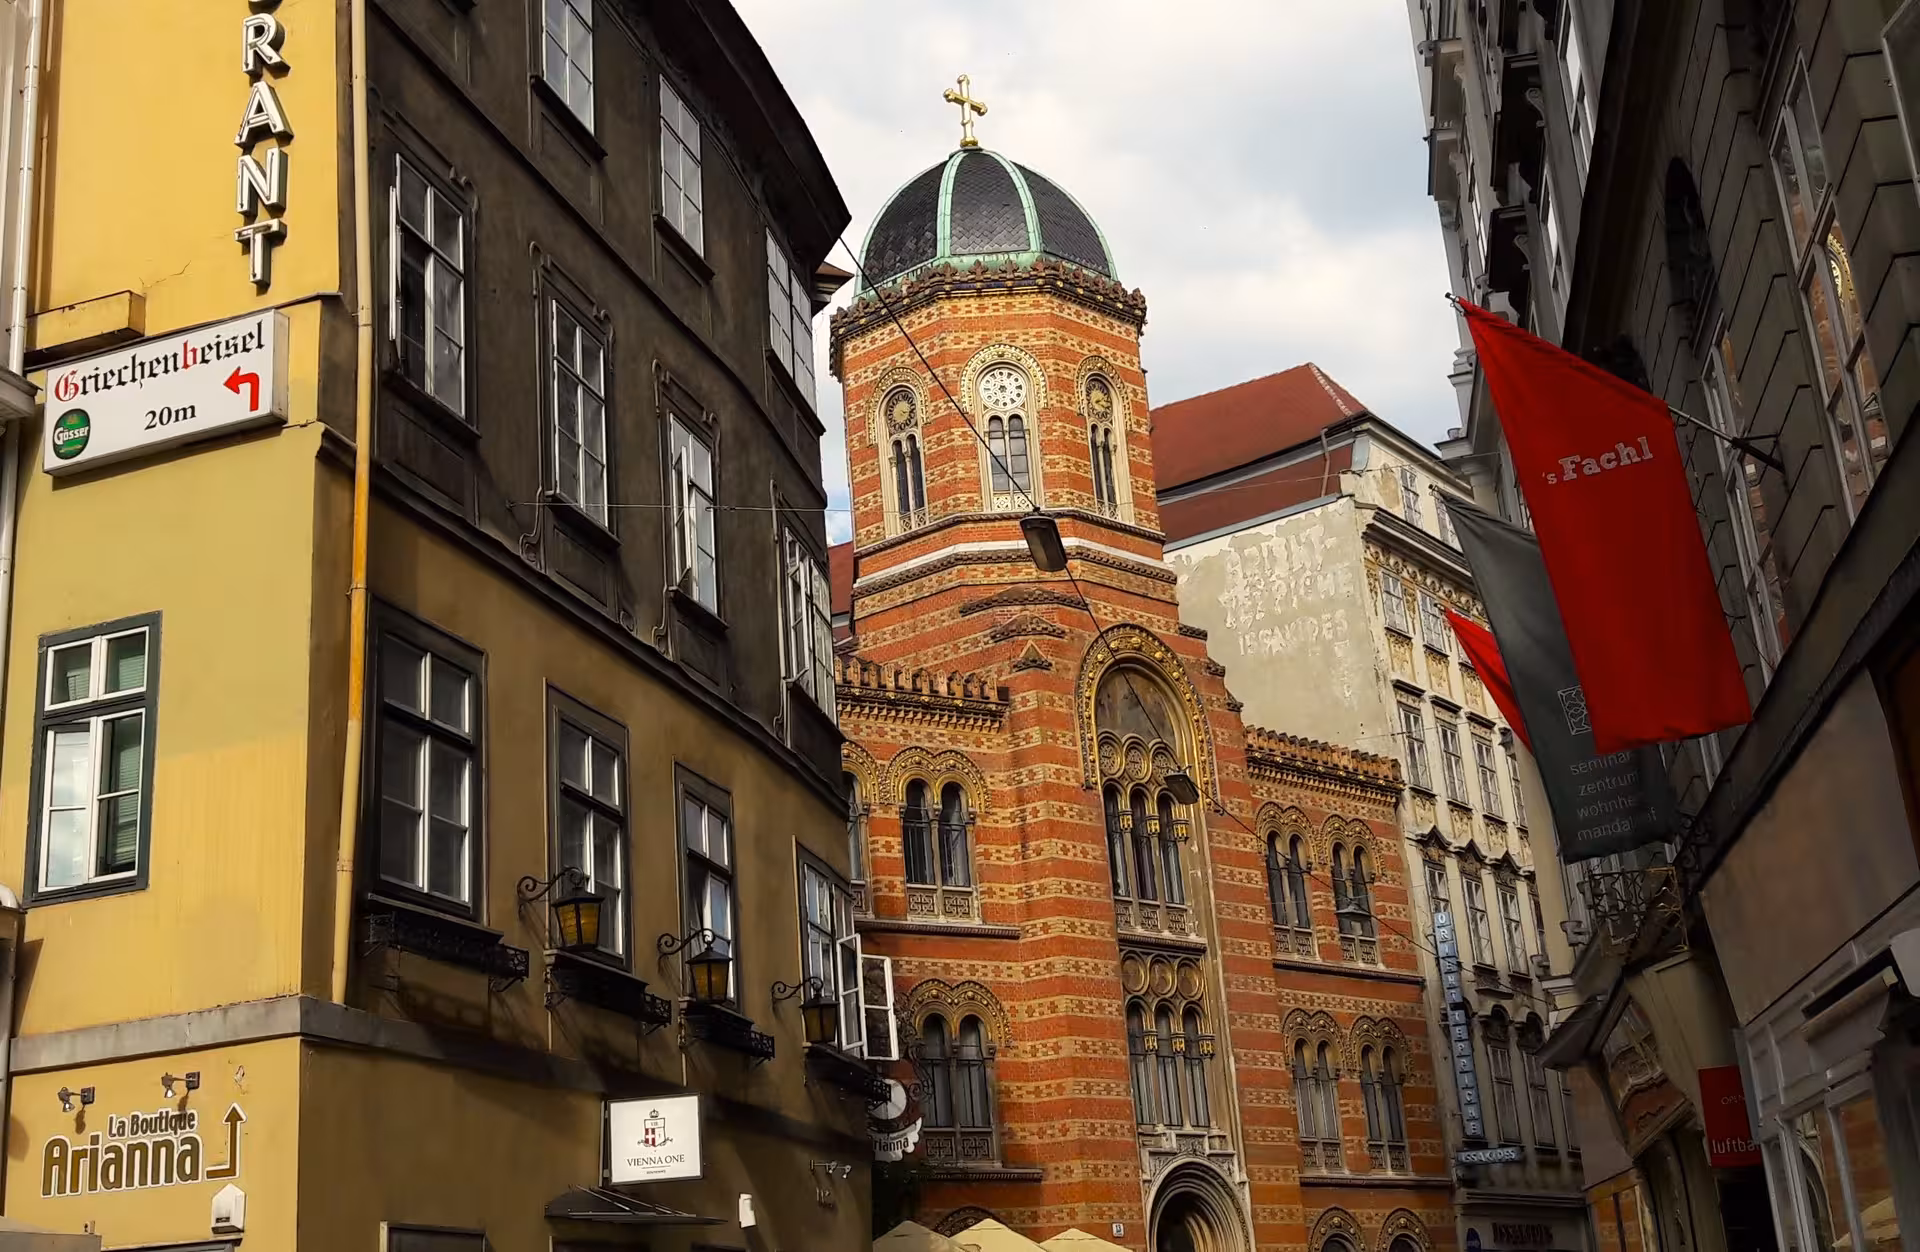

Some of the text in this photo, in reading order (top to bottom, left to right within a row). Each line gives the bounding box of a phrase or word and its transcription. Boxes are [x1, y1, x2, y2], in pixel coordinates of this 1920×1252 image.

[234, 0, 293, 296] RANT
[54, 319, 265, 403] Griechenbeisel
[144, 404, 197, 431] 20m
[54, 424, 90, 446] Gösser
[1558, 436, 1654, 482] Fachl
[108, 1110, 196, 1138] La Boutique
[873, 1137, 910, 1152] rianna
[42, 1134, 201, 1196] Arianna
[626, 1154, 685, 1167] VIENNA ONE
